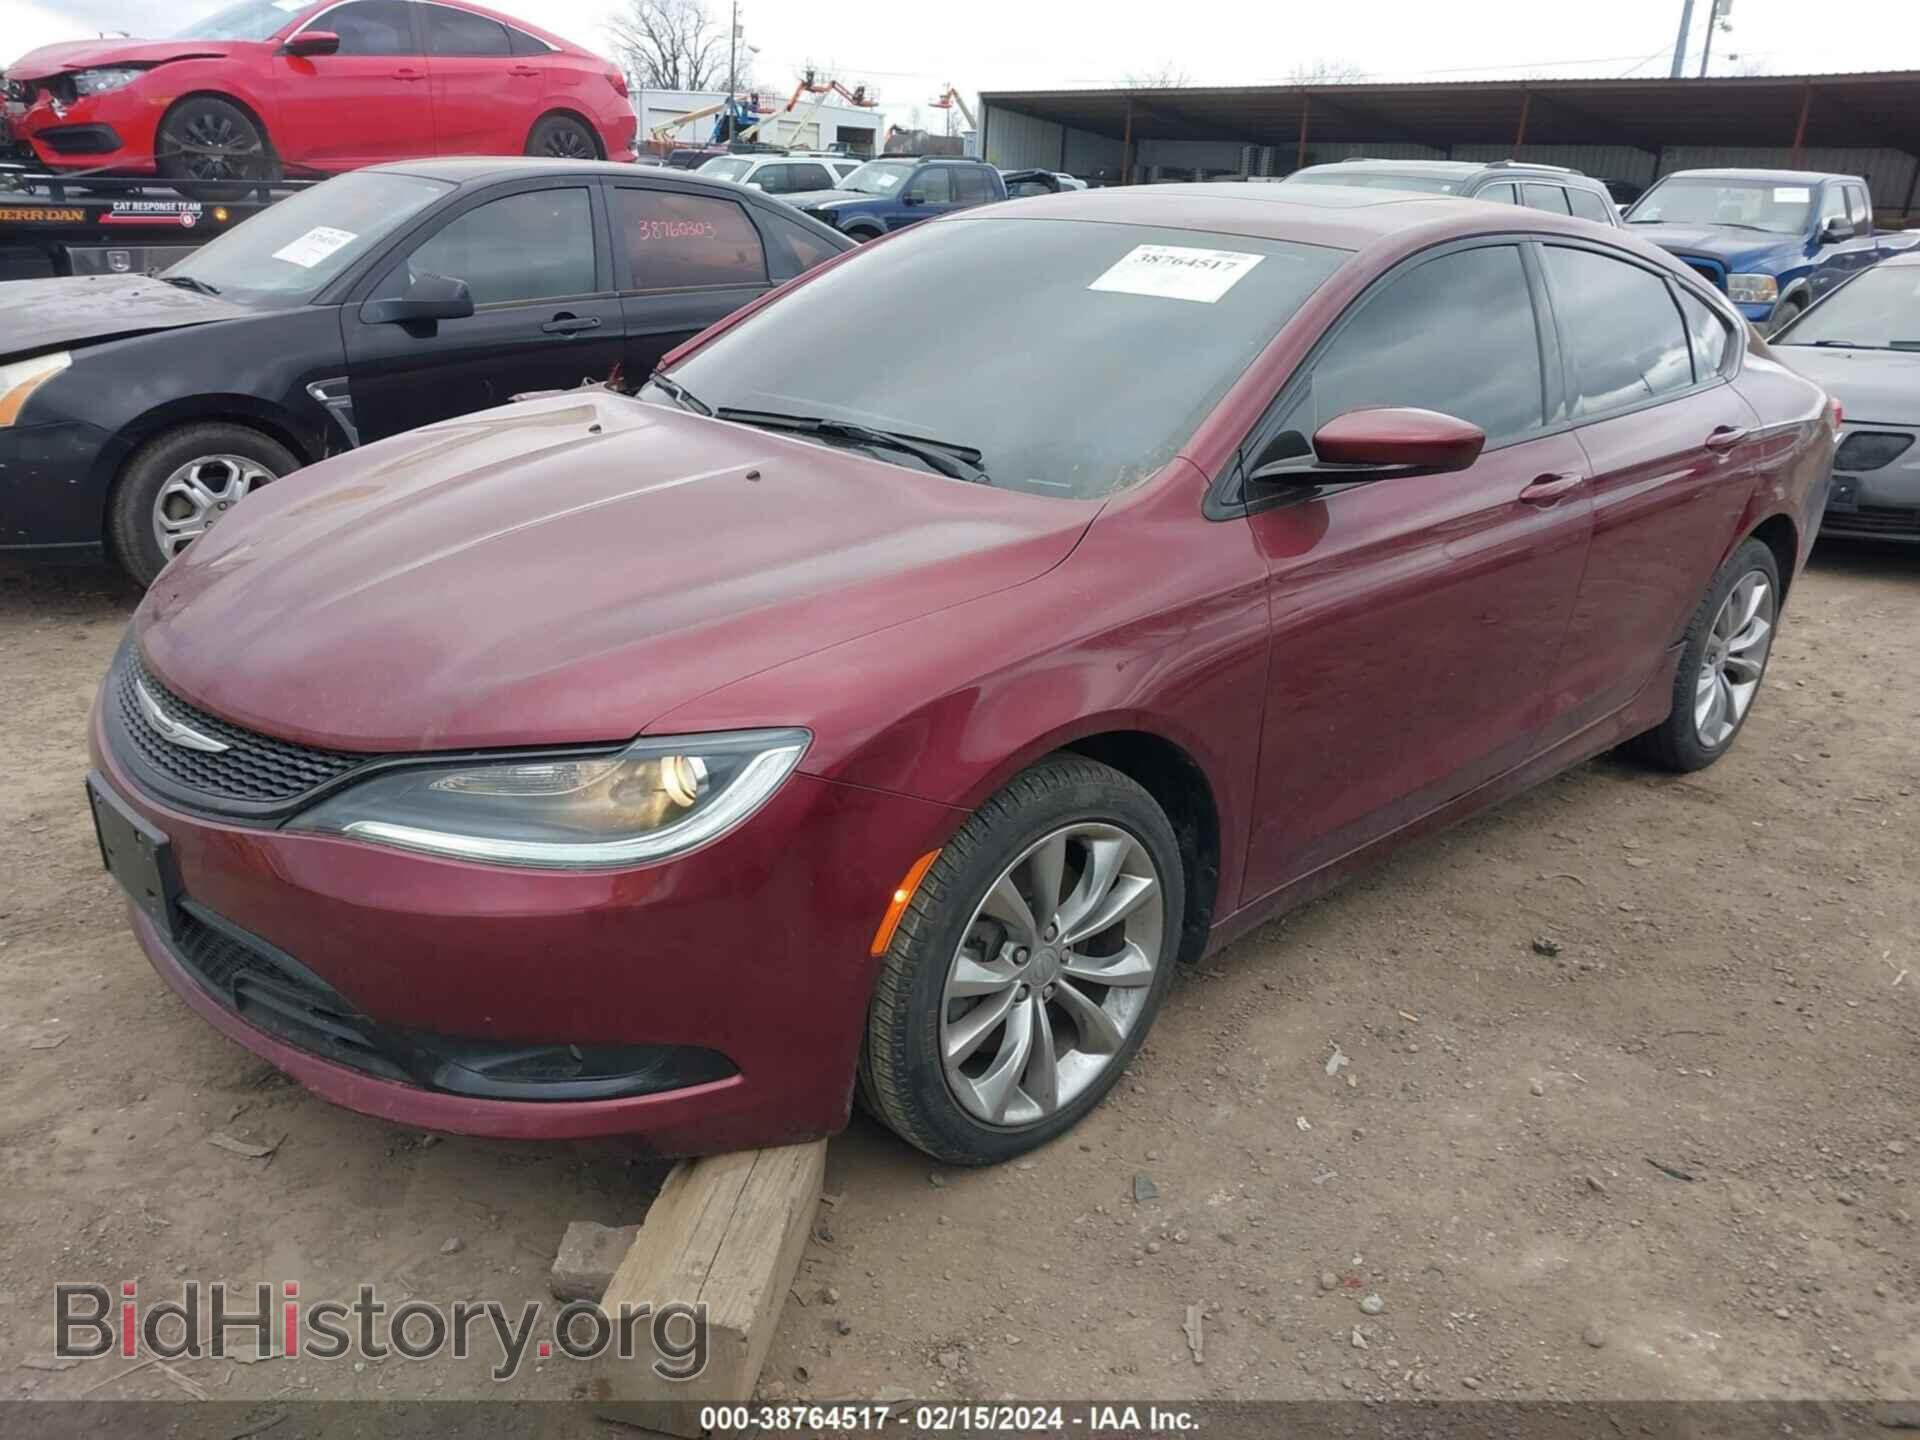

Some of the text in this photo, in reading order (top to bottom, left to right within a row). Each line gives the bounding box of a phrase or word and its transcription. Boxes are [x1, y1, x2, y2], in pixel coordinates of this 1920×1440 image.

[113, 202, 201, 211] CAT RESPONSE TEAM
[640, 220, 716, 240] 38760303
[1134, 252, 1238, 271] 38764517
